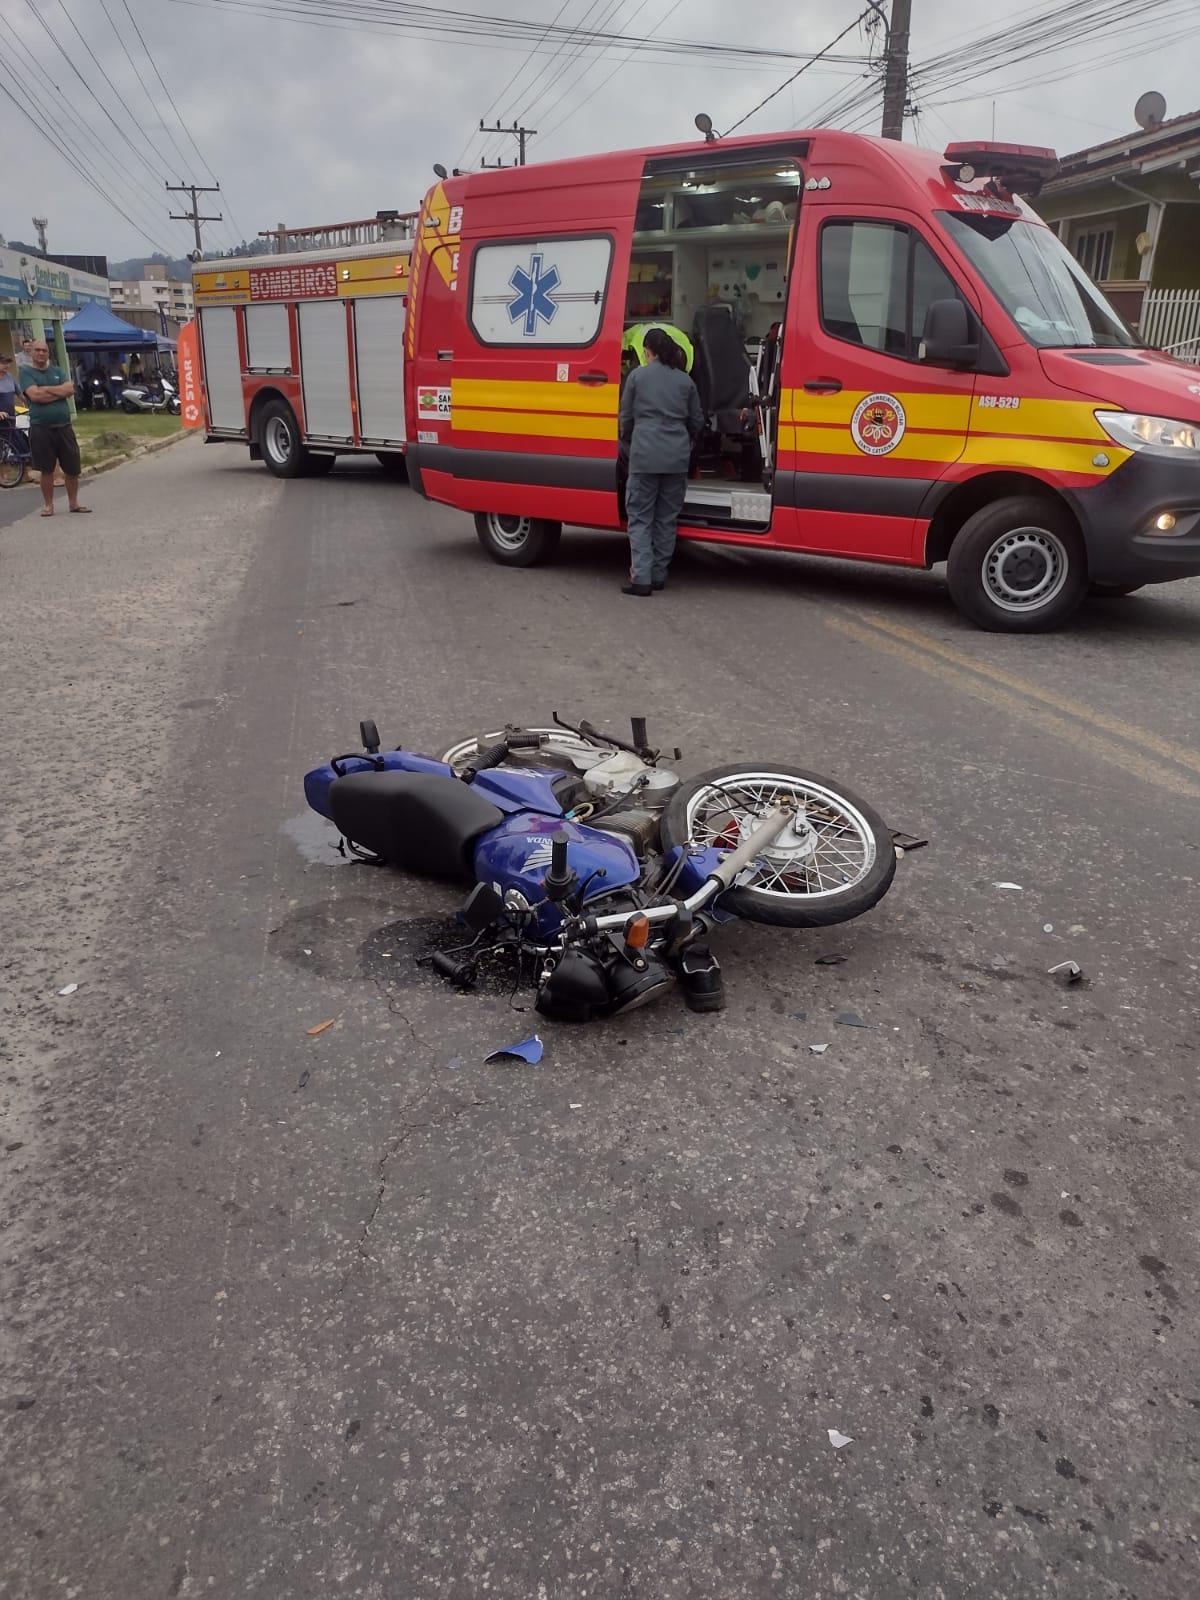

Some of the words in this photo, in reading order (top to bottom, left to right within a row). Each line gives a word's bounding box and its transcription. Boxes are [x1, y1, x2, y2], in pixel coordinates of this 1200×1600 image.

[250, 266, 337, 299] BOMBEIROS
[184, 359, 194, 401] STAR
[978, 395, 1019, 409] ASU-529
